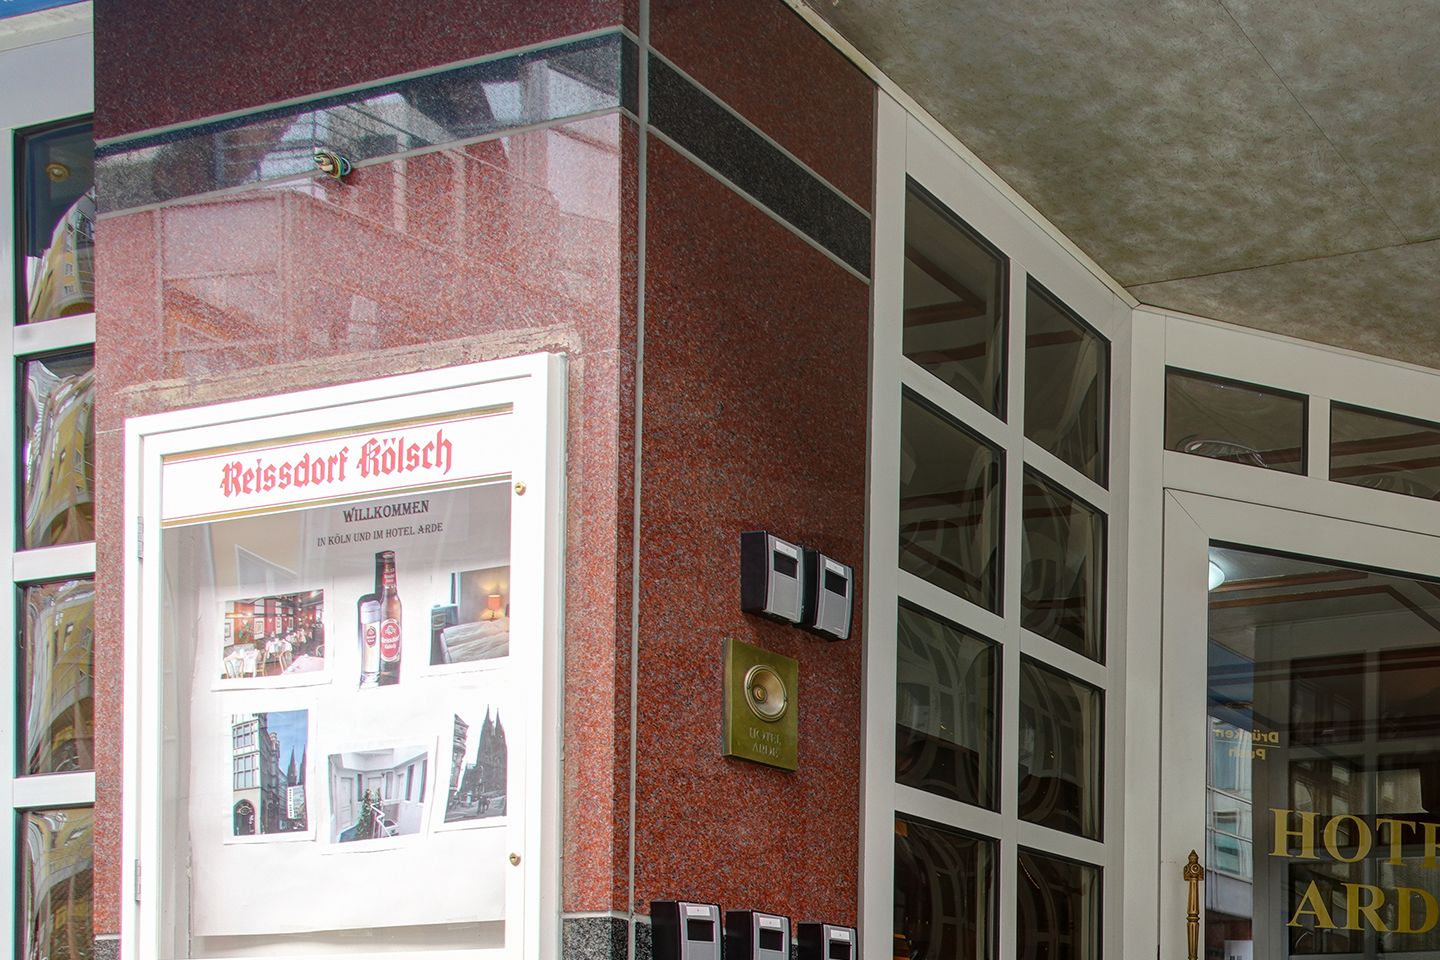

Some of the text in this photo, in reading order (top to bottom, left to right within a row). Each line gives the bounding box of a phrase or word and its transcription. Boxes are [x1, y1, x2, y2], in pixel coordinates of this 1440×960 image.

[220, 428, 453, 498] Reissdorf Kölsch
[343, 500, 430, 523] WILLKOMMEN
[317, 522, 444, 547] IN KÖLN UND IM HOTEL ARDE
